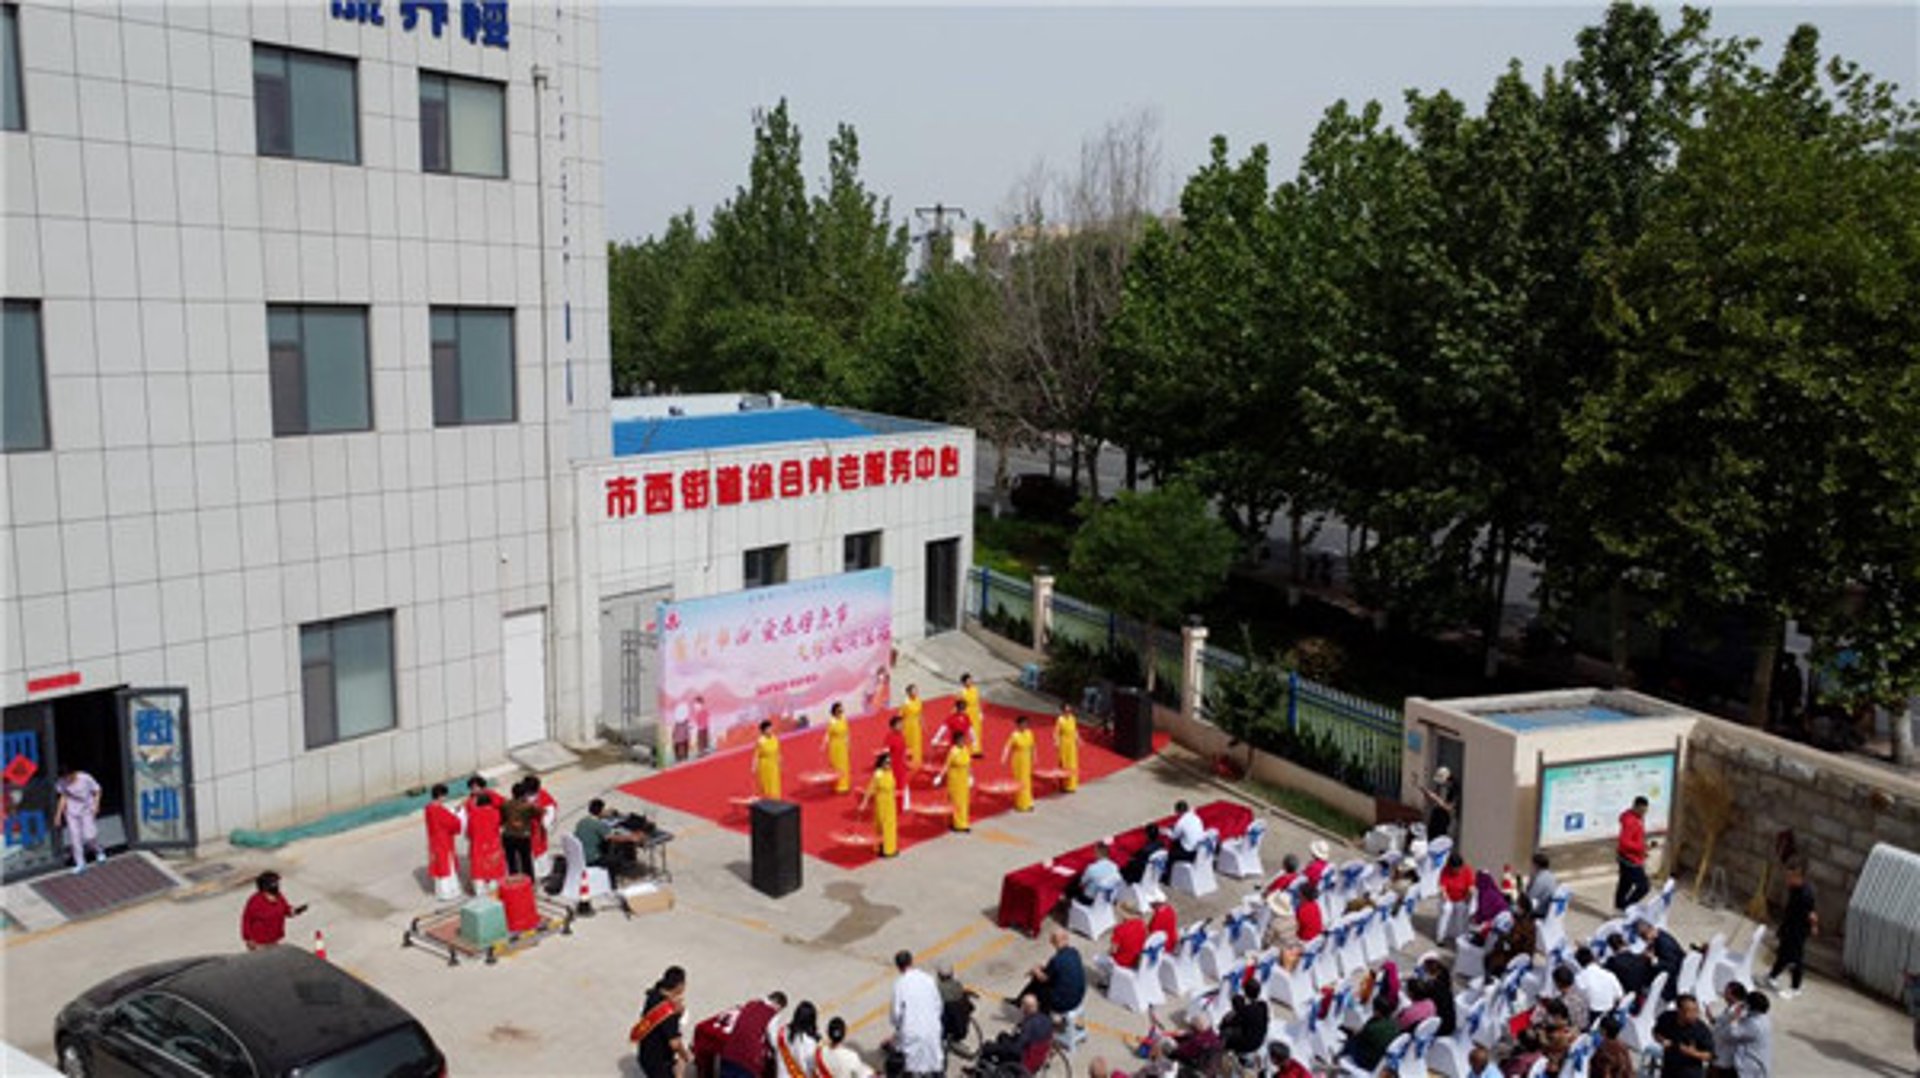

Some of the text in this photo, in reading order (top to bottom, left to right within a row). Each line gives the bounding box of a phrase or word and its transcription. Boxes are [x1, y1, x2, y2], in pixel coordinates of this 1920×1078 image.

[605, 444, 960, 519] 市西街道综合养老服务中心
